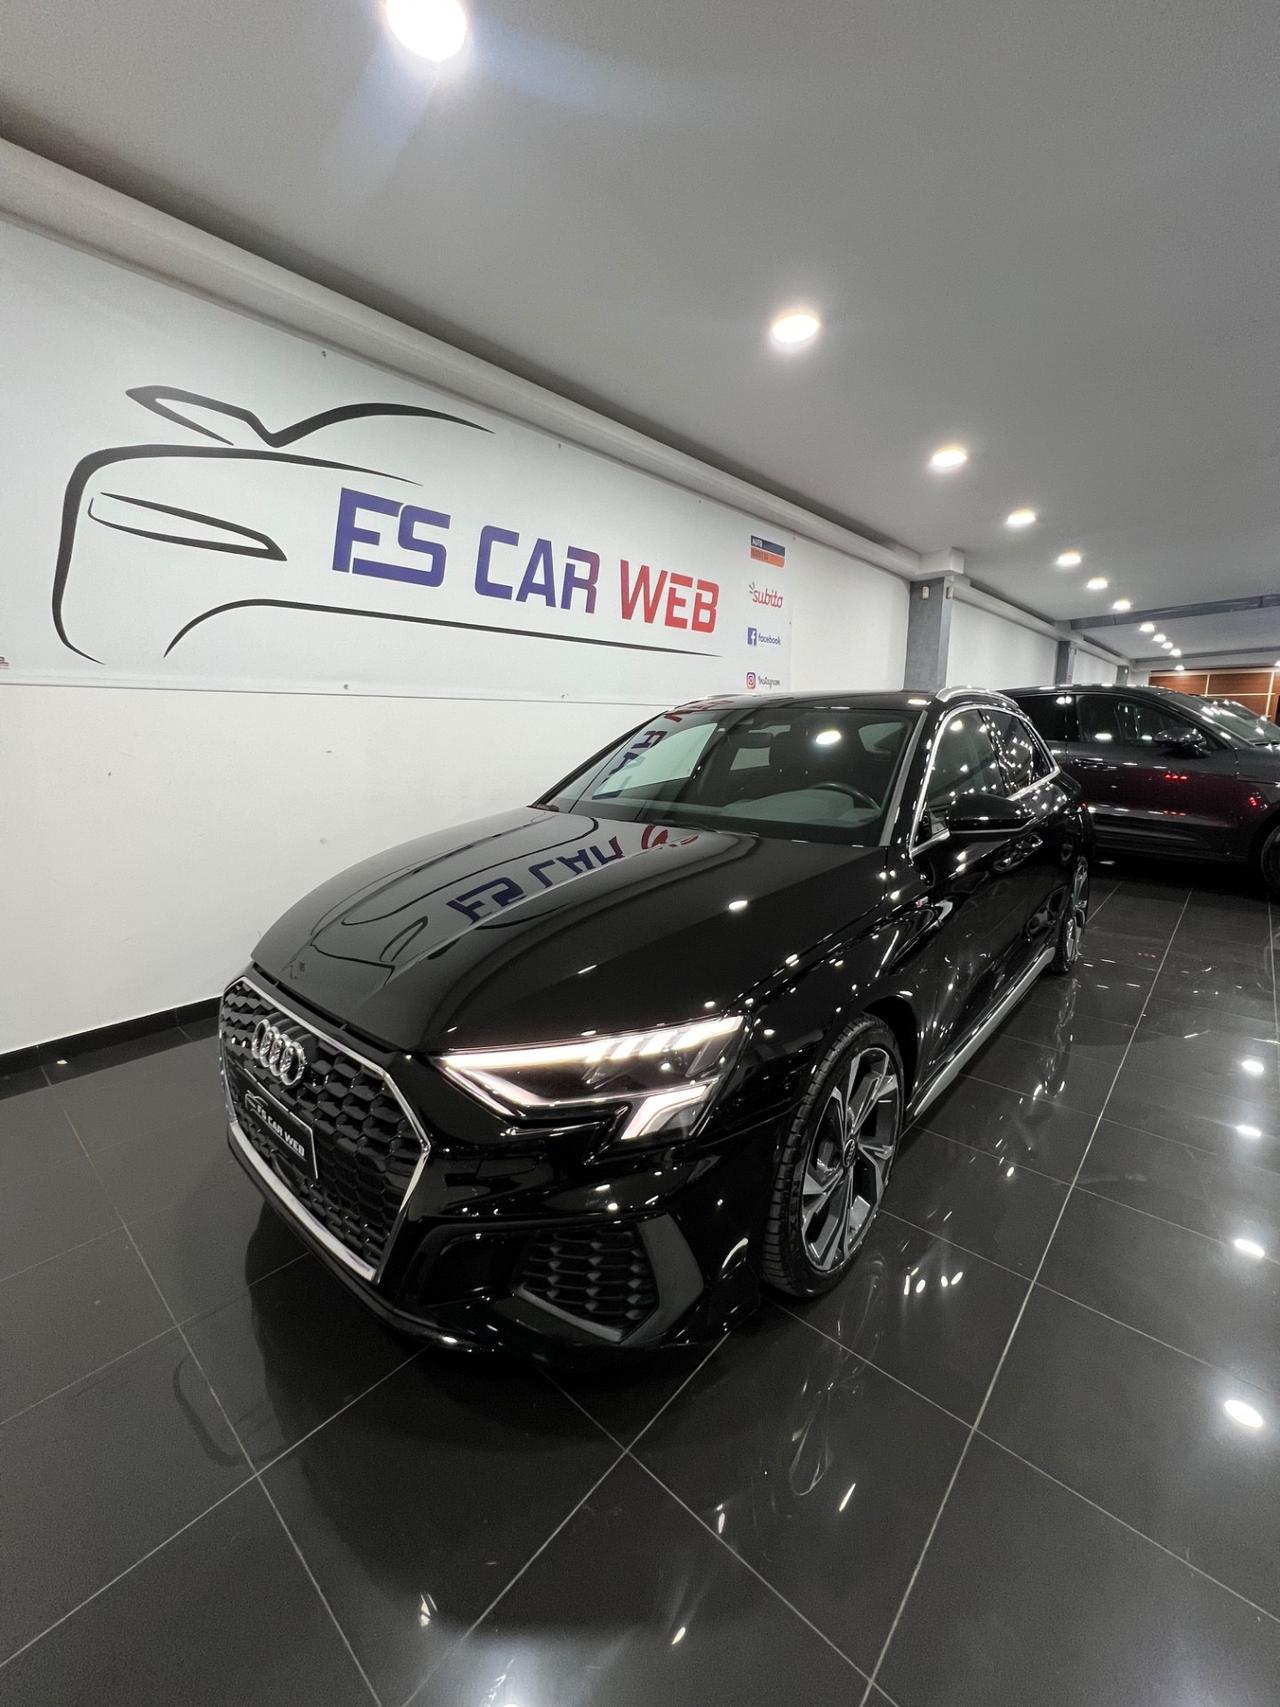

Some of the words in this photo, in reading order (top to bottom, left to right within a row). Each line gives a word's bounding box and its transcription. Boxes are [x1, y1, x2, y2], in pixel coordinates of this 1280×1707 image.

[332, 487, 451, 588] ES
[475, 525, 600, 614] CAR
[620, 560, 720, 634] WEB
[752, 587, 783, 608] subito
[758, 632, 781, 645] facebook
[285, 1131, 305, 1157] WEB
